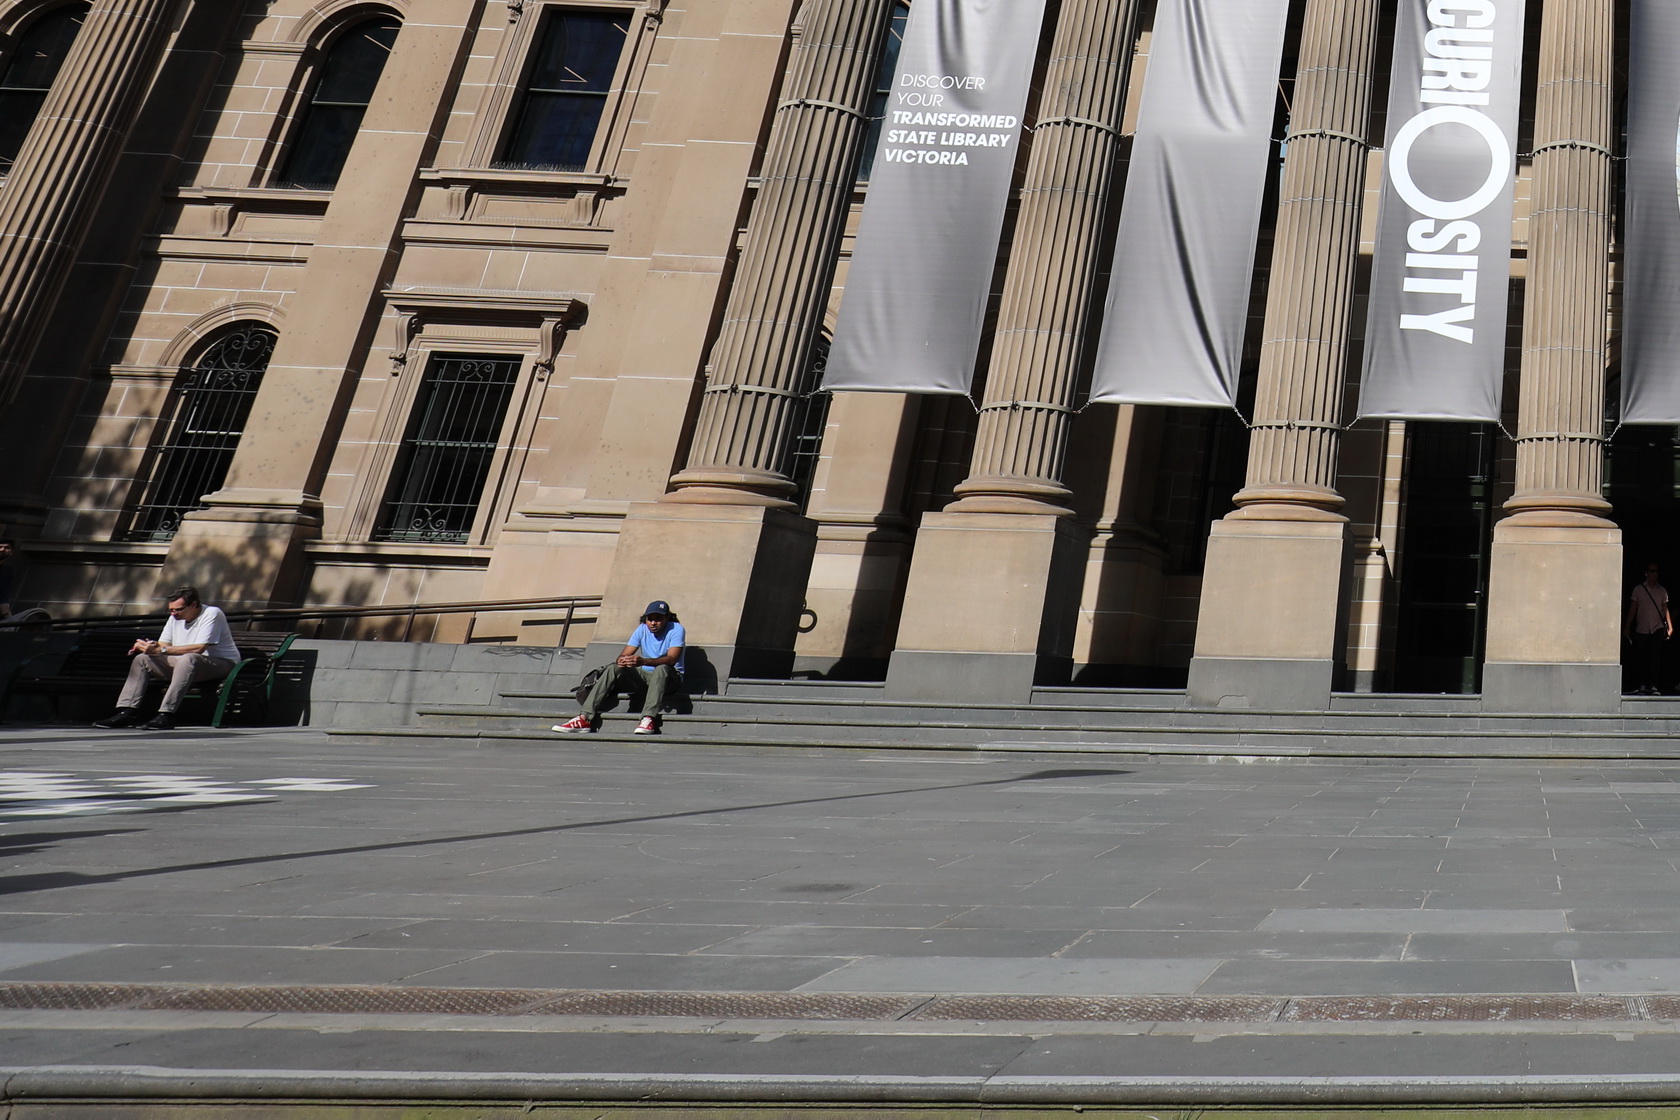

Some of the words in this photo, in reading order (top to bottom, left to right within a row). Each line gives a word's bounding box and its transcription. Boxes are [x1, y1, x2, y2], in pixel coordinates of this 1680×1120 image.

[900, 73, 986, 90] DISCOVER
[897, 91, 944, 107] YOUR
[892, 110, 1017, 129] TRANSFORMED
[887, 129, 937, 145] STATE
[940, 131, 1011, 147] LIBRARY
[884, 148, 969, 166] VICTORIA
